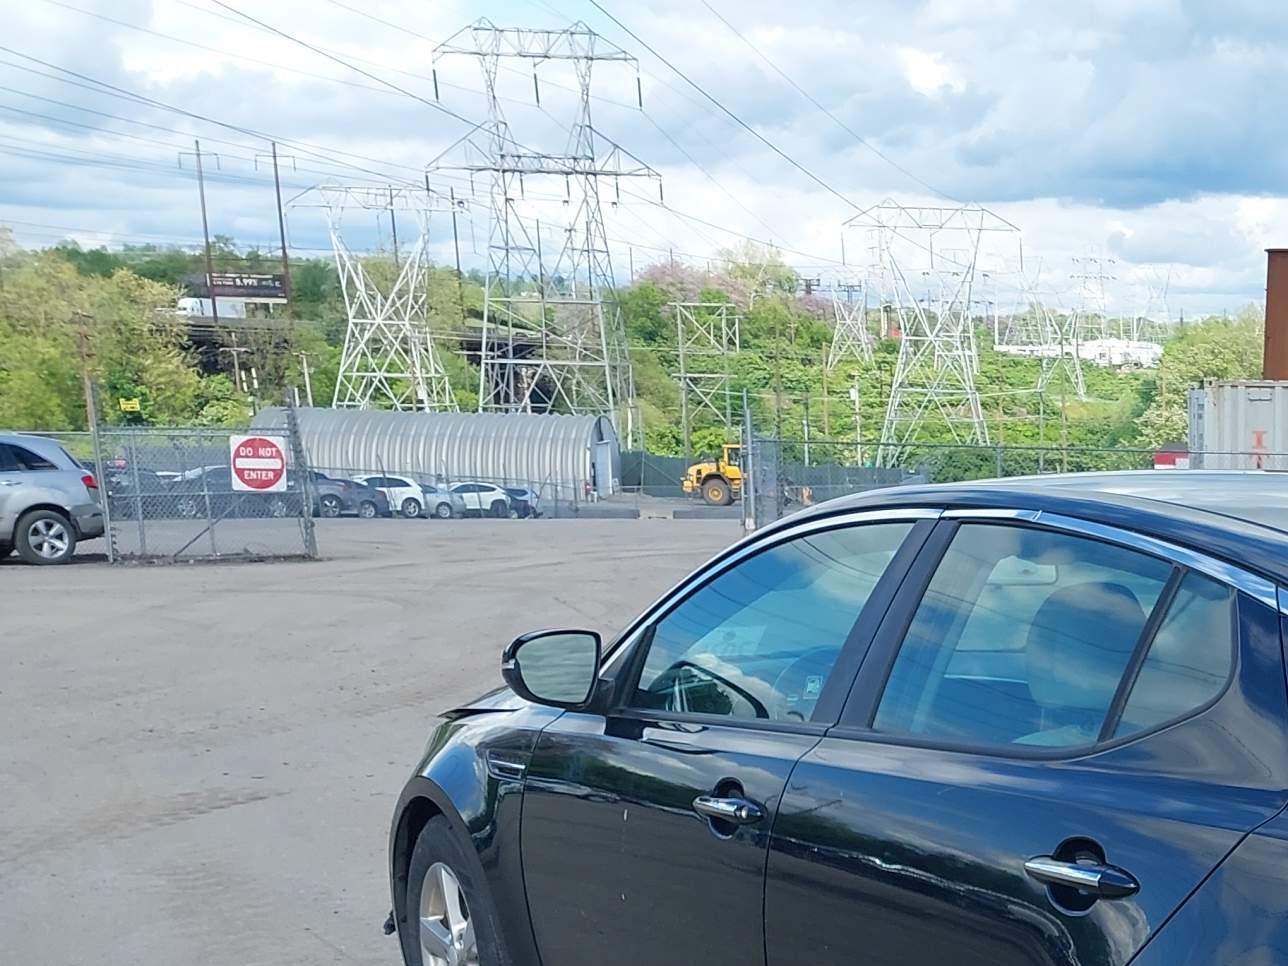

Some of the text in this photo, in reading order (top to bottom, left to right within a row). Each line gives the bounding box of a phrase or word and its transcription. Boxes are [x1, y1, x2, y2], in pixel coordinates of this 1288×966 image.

[240, 447, 276, 457] DO NOT
[244, 470, 274, 480] ENTER
